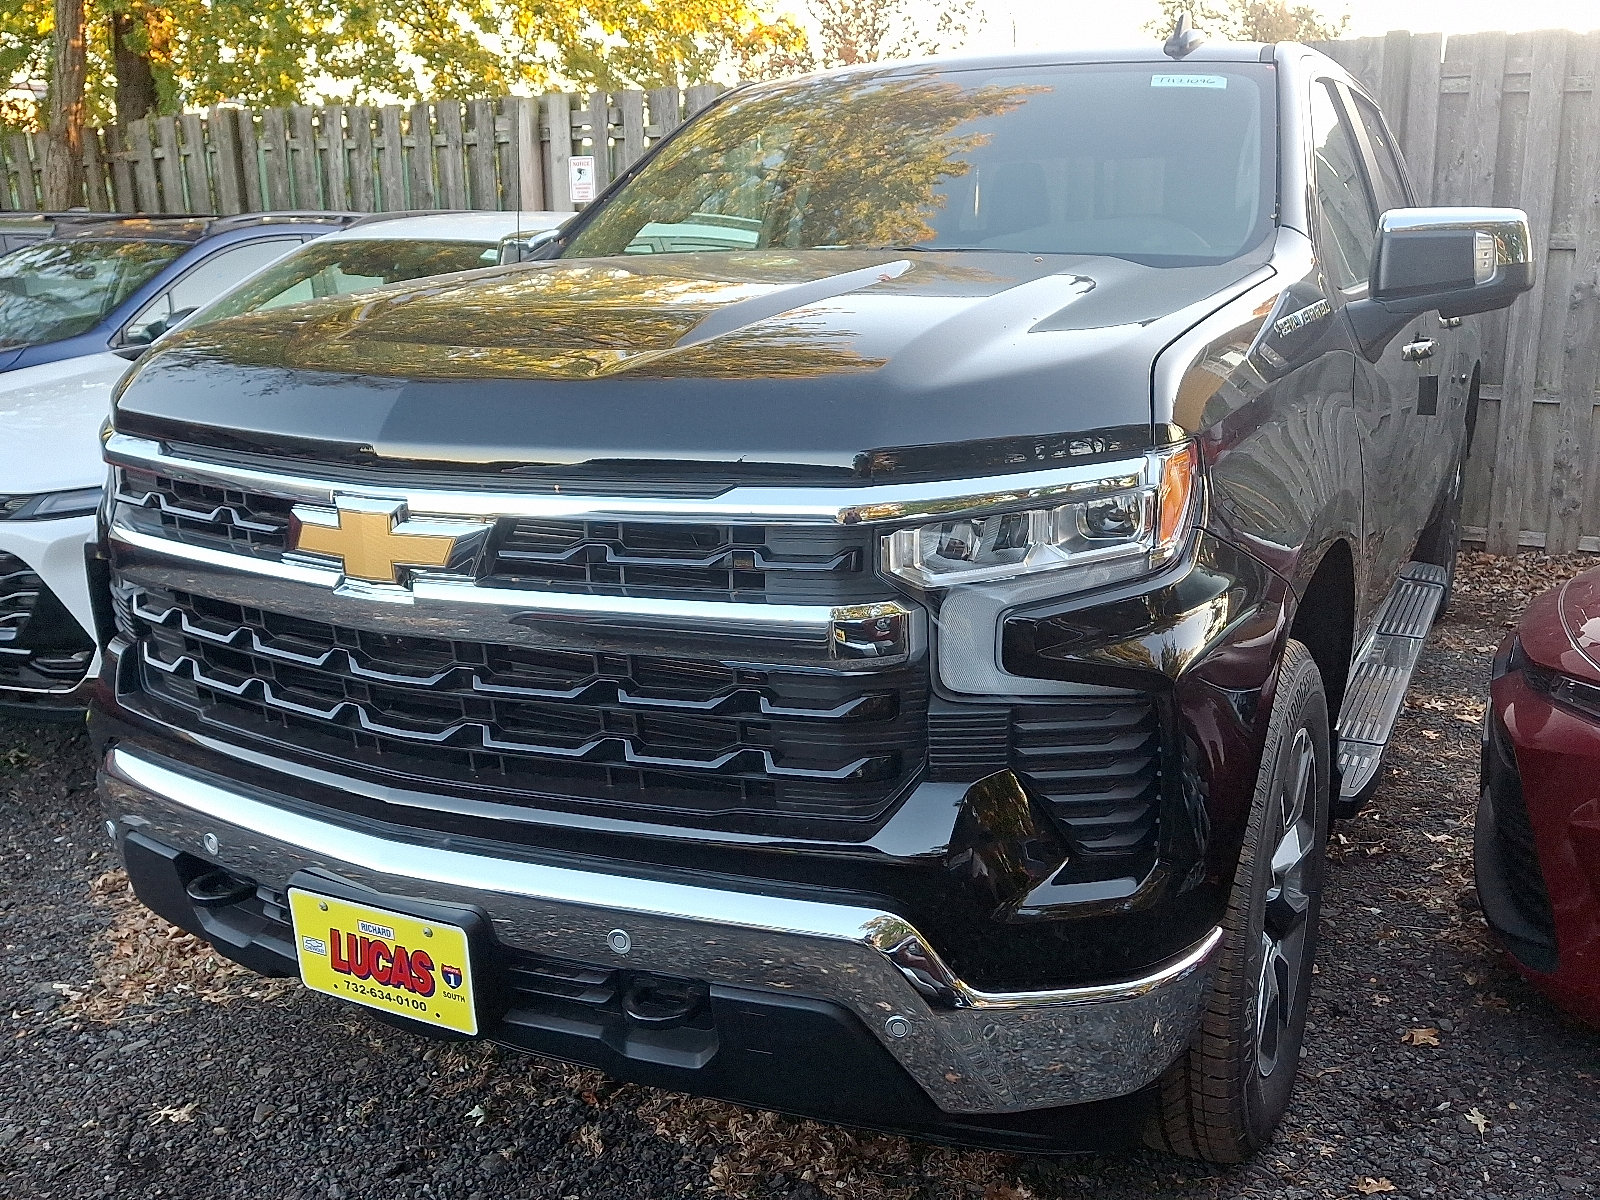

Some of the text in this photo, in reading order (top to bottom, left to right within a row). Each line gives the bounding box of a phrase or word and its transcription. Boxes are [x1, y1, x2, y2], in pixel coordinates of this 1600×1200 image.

[360, 922, 392, 938] RICHARD
[329, 927, 436, 998] LUCAS
[447, 973, 457, 988] 1
[343, 980, 427, 1012] 732-634-0100
[442, 990, 466, 1003] SOUTH
